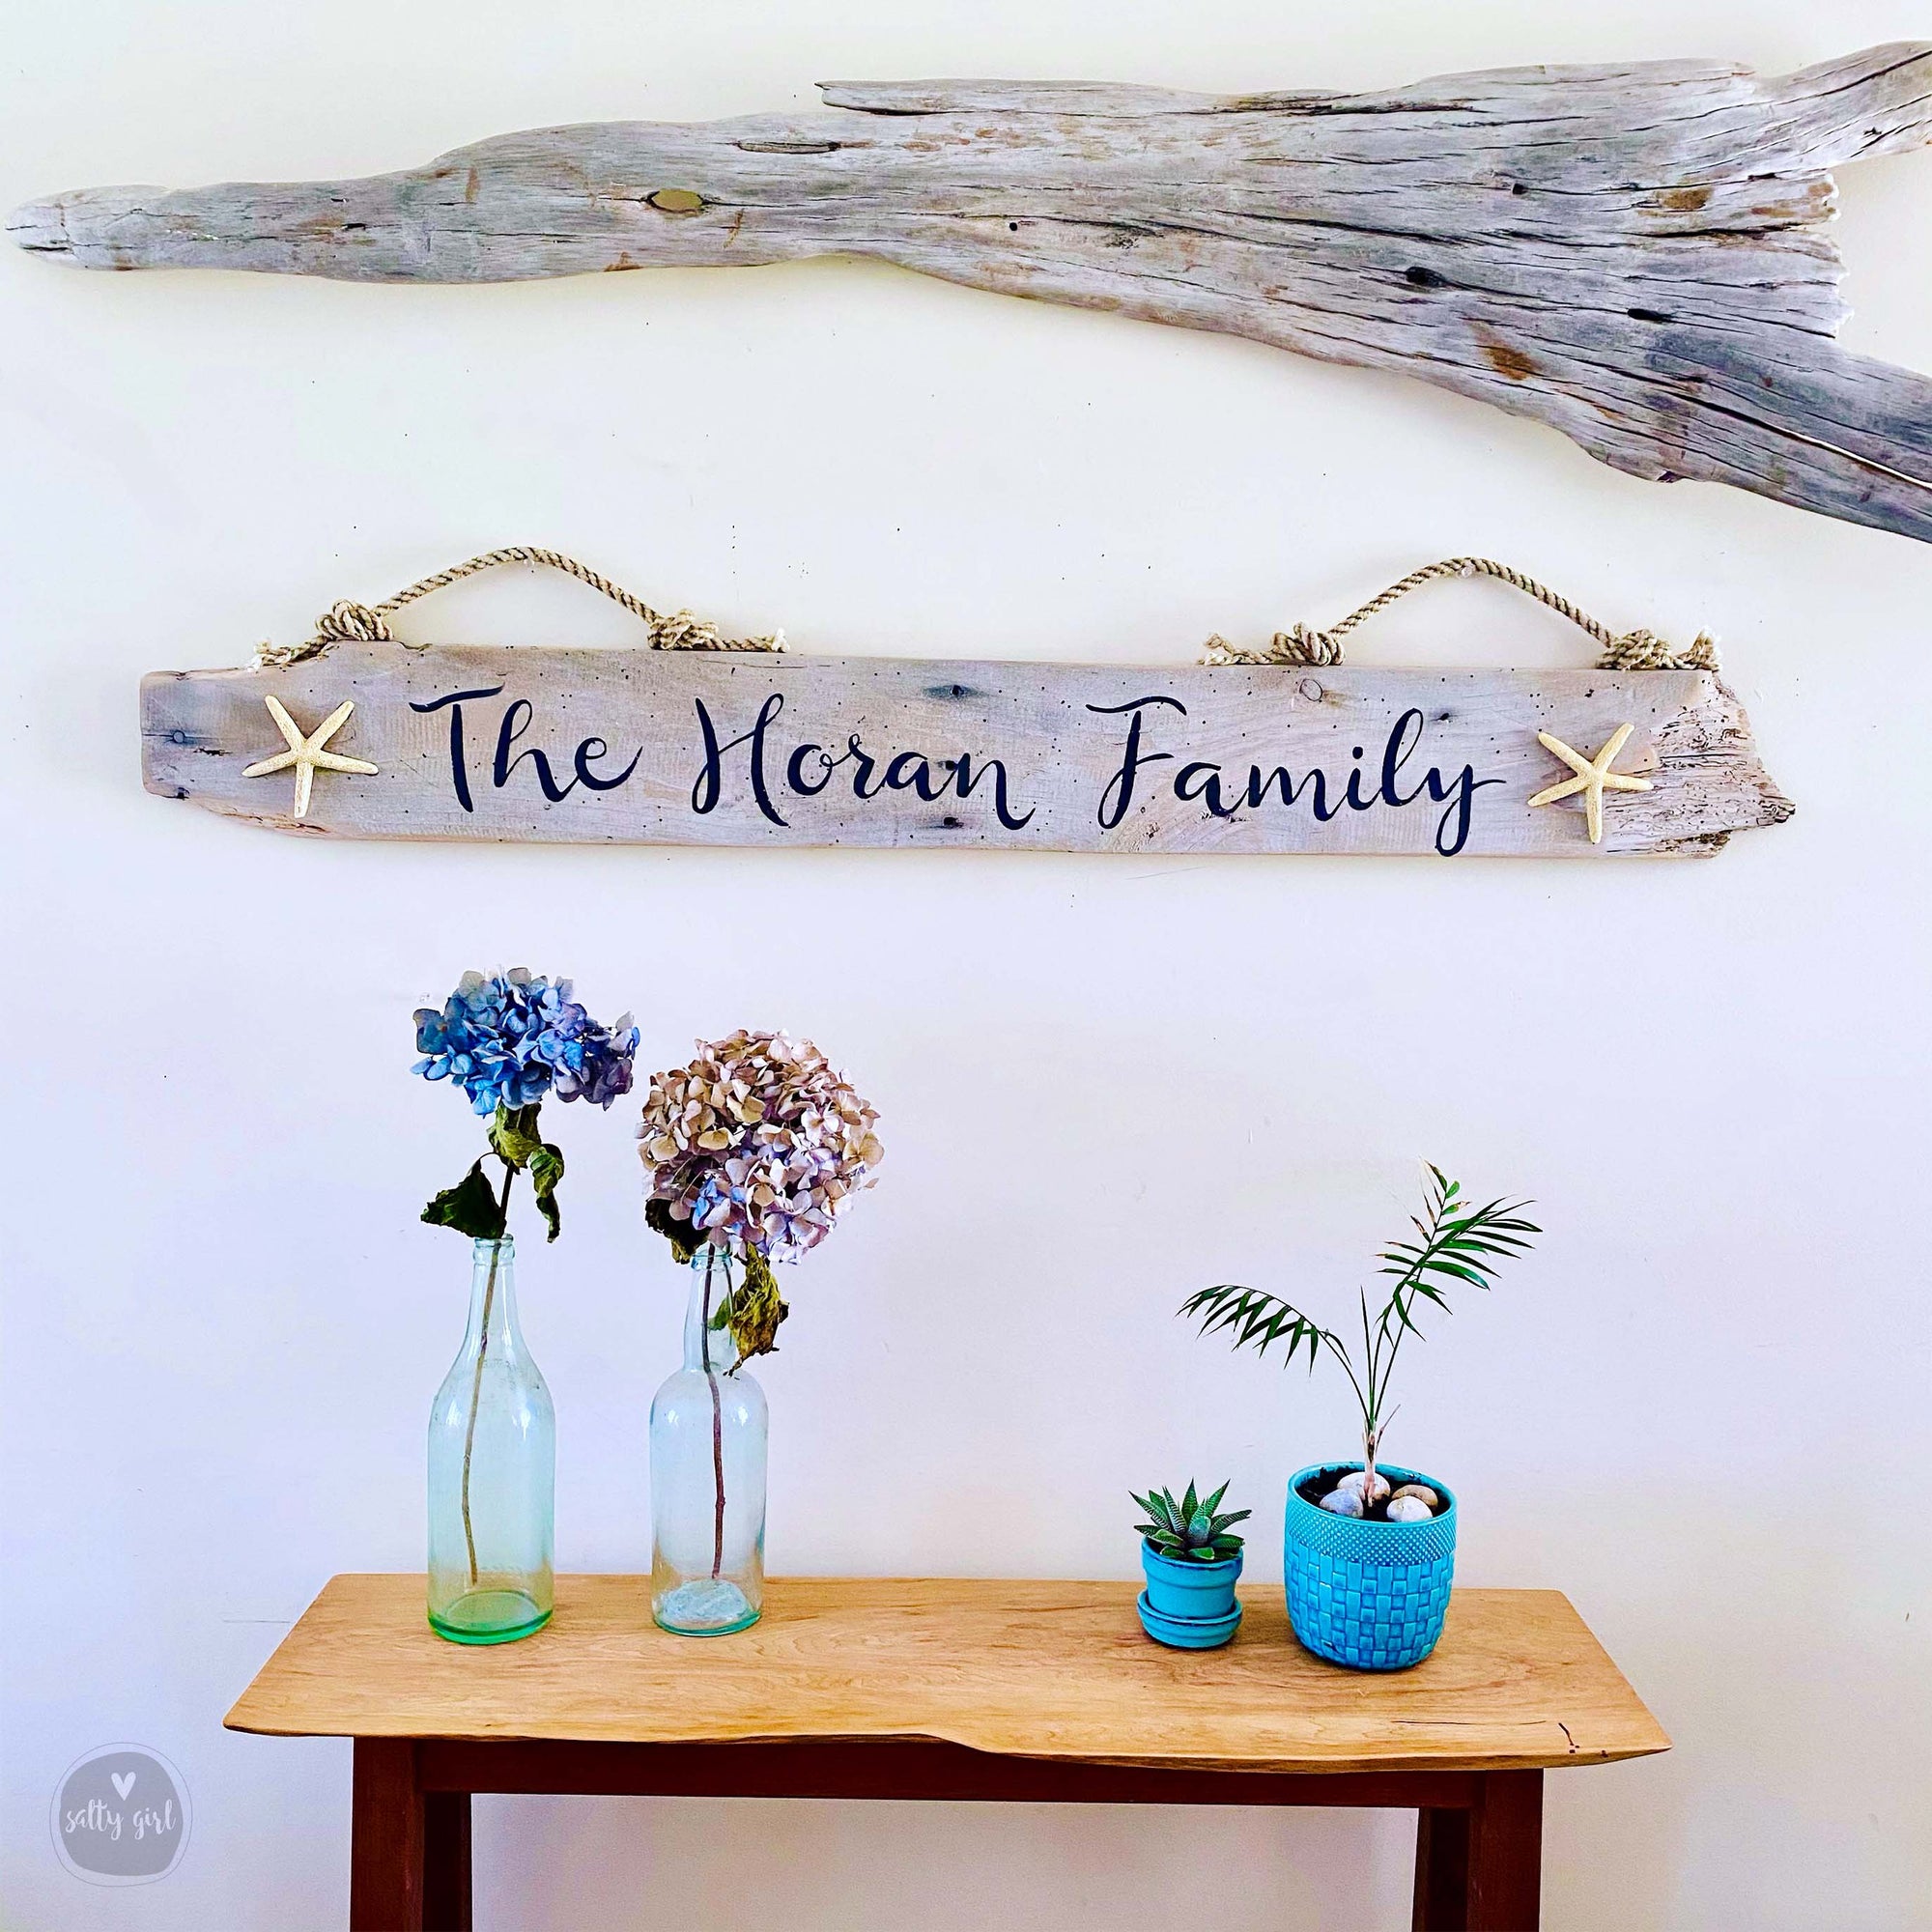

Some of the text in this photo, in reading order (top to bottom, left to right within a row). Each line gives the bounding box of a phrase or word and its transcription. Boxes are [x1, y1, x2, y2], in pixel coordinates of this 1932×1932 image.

[408, 685, 1507, 859] The Horan Family
